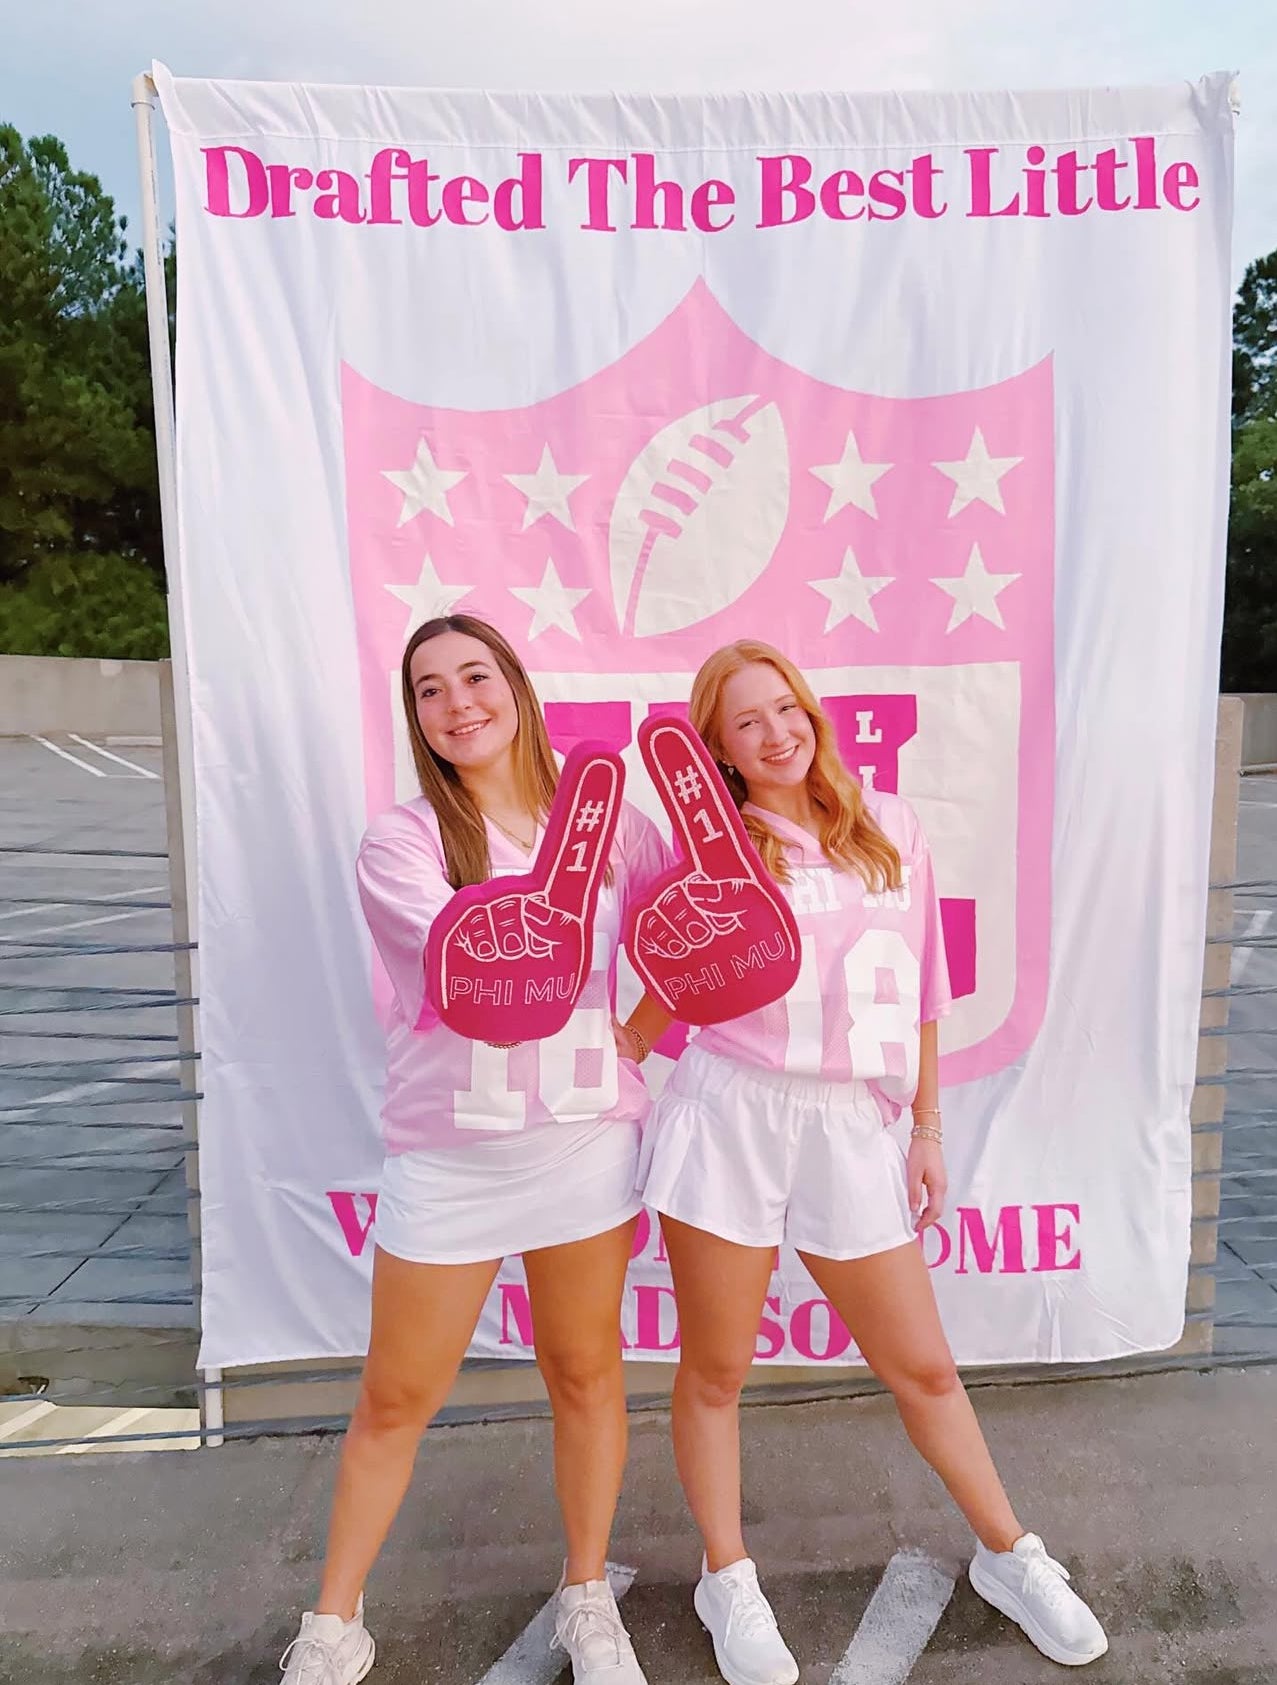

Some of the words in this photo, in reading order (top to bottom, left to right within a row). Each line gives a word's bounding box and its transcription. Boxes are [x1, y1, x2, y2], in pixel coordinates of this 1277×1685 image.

[200, 145, 546, 231] Drafted
[568, 152, 735, 232] The
[755, 154, 948, 229] Best
[963, 136, 1200, 218] Little
[449, 975, 513, 1005] PHI
[524, 972, 576, 1005] MU
[663, 962, 726, 1000] PHI
[730, 931, 786, 979] MU
